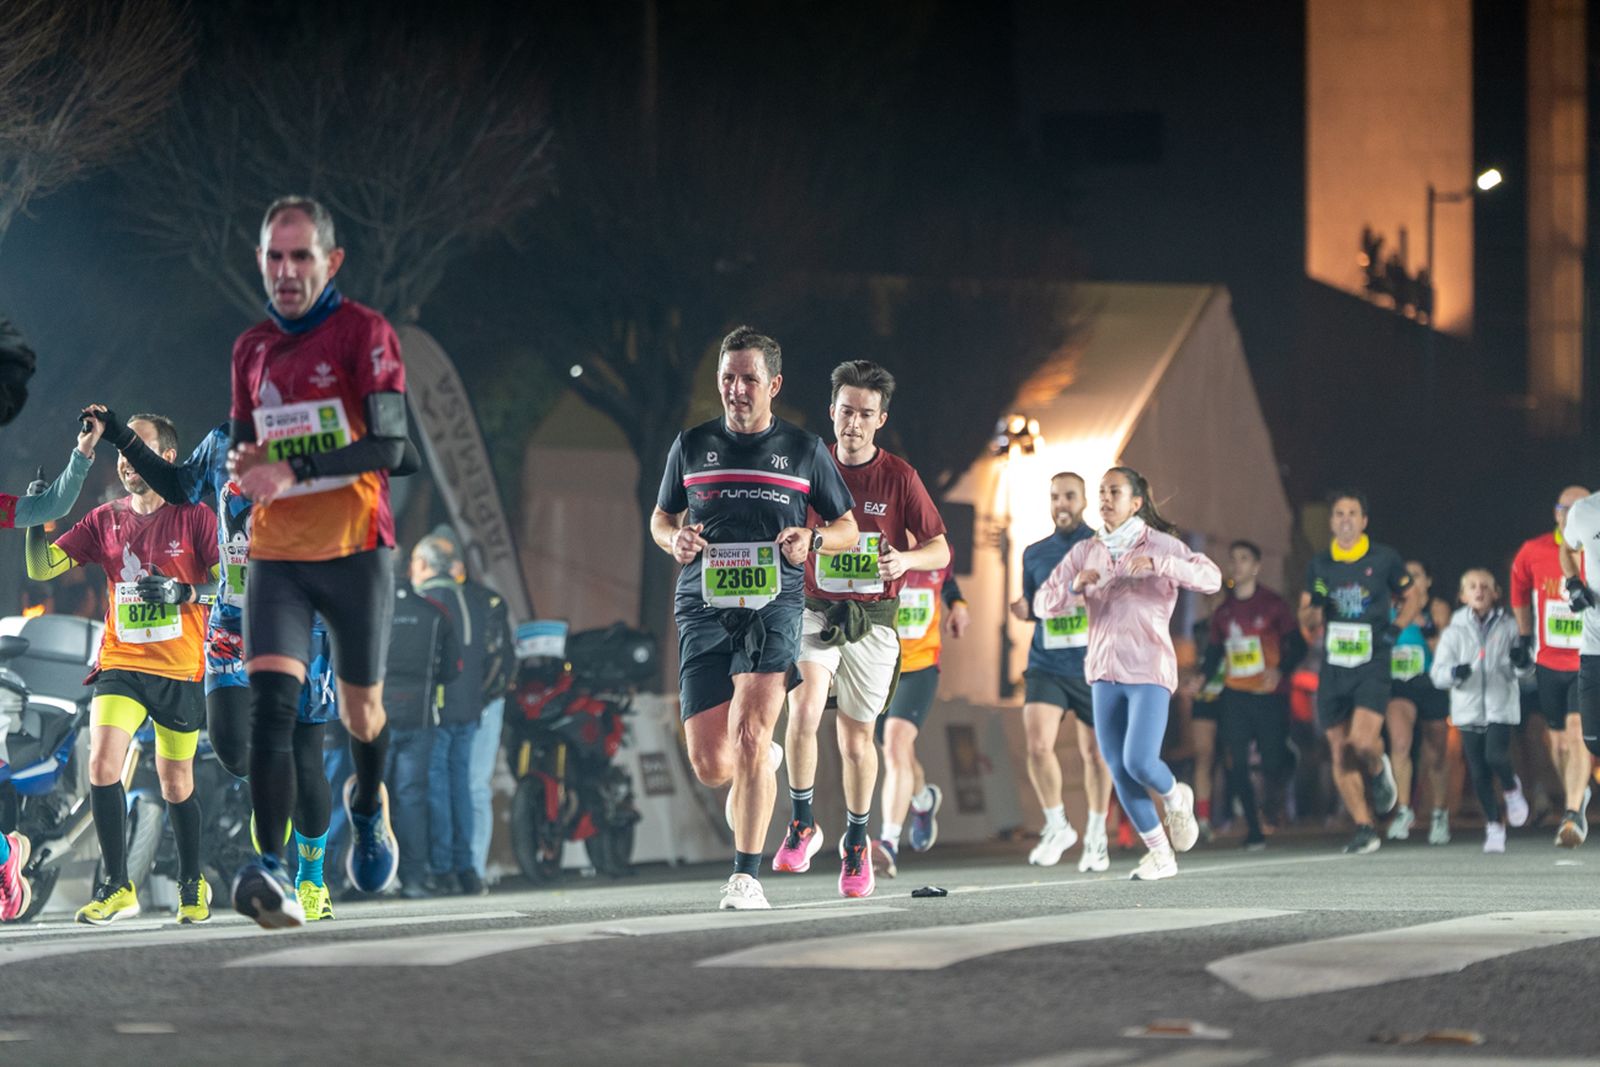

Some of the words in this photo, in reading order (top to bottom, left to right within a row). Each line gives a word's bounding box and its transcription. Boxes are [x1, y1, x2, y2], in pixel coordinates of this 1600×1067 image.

[864, 501, 887, 513] EA7
[718, 550, 740, 559] NOCHE
[741, 550, 750, 558] DE
[830, 553, 872, 573] 4912
[716, 567, 766, 589] 2360
[128, 604, 166, 622] 8721
